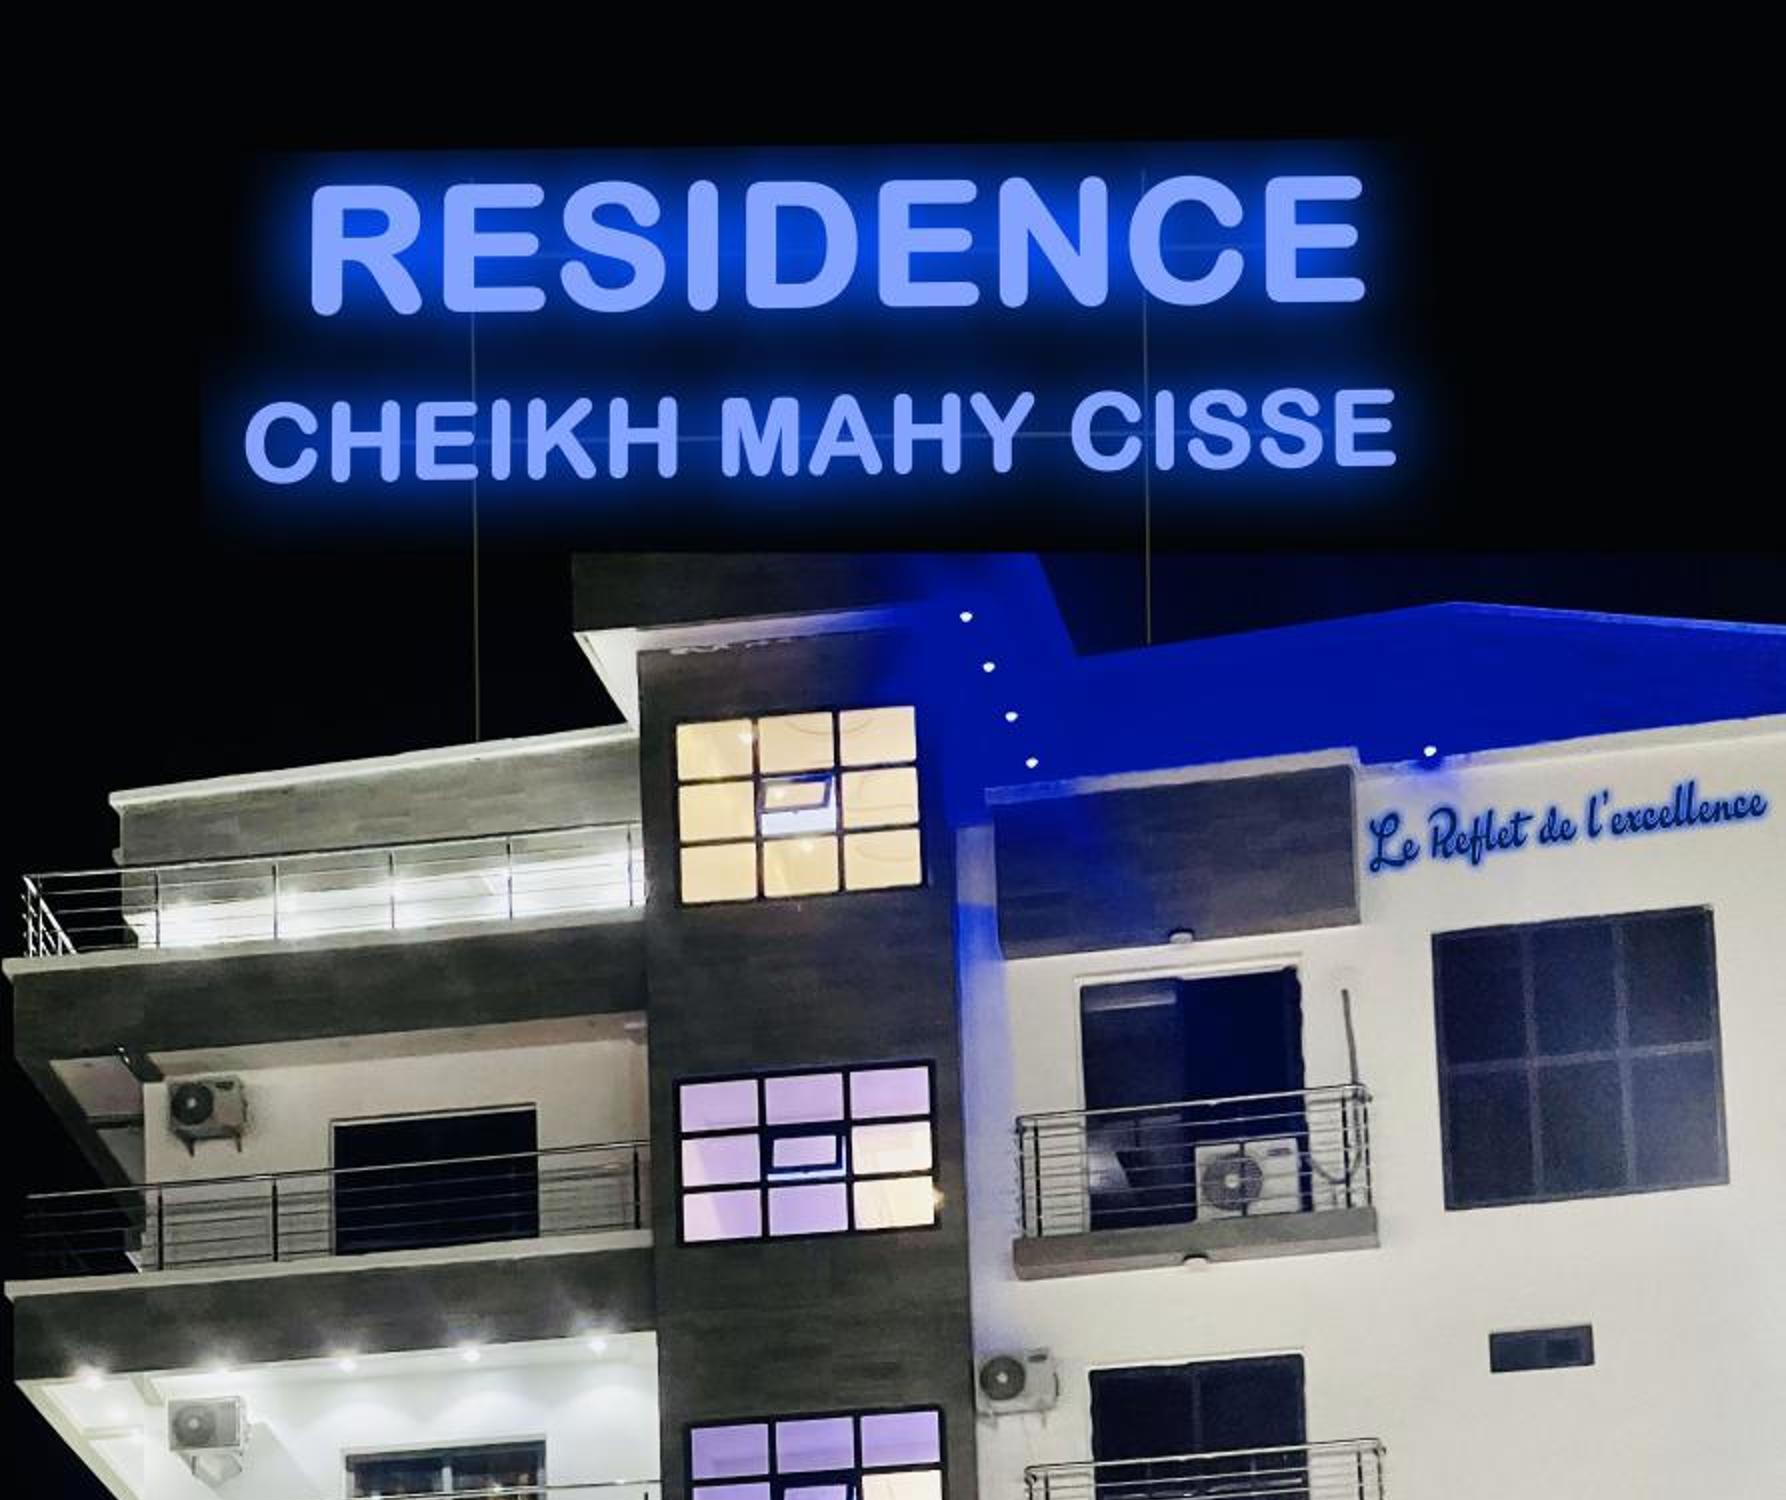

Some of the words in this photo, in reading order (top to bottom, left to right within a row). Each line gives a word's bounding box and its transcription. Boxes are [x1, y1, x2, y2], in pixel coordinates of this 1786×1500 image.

[310, 175, 1367, 316] RESIDENCE
[244, 396, 681, 484] CHEIKH
[721, 391, 1036, 478] MAHY
[1070, 387, 1397, 472] CISSE
[1369, 810, 1420, 872] Le
[1427, 806, 1533, 866] Reflet
[1539, 805, 1578, 846] de
[1588, 780, 1768, 839] l'excellence
